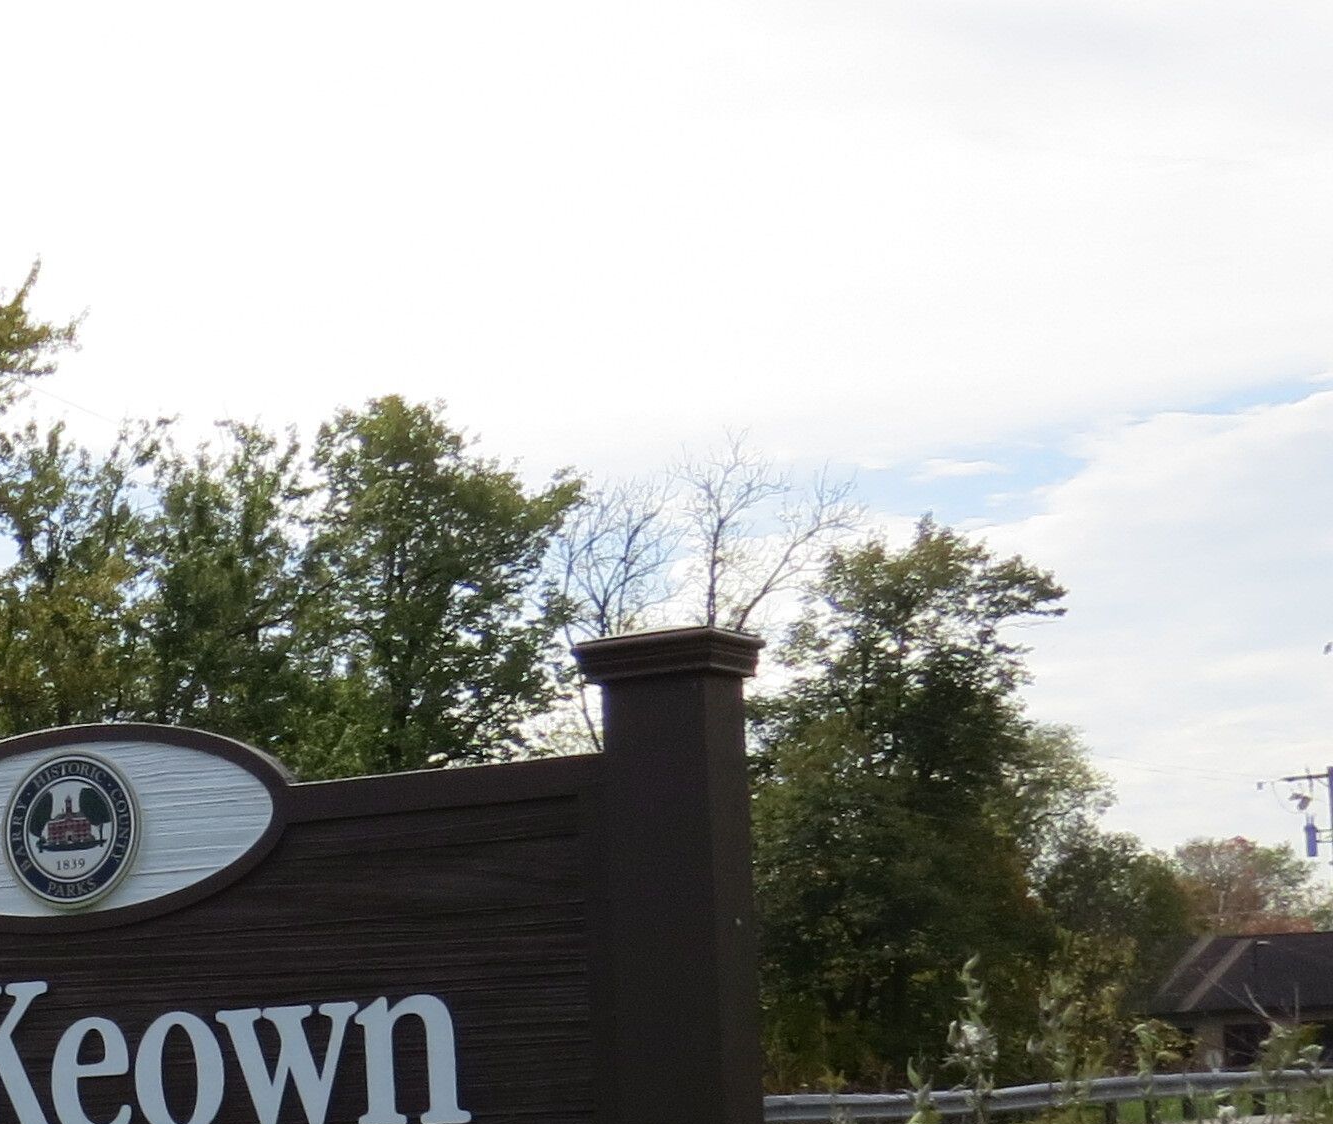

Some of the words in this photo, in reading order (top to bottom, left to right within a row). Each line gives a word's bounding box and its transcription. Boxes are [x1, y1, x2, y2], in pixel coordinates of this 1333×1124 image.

[32, 761, 108, 790] HISTORIC
[11, 799, 34, 873] BARRY
[109, 786, 132, 863] COUNTY
[56, 857, 86, 871] 1839
[46, 877, 98, 897] PARKS
